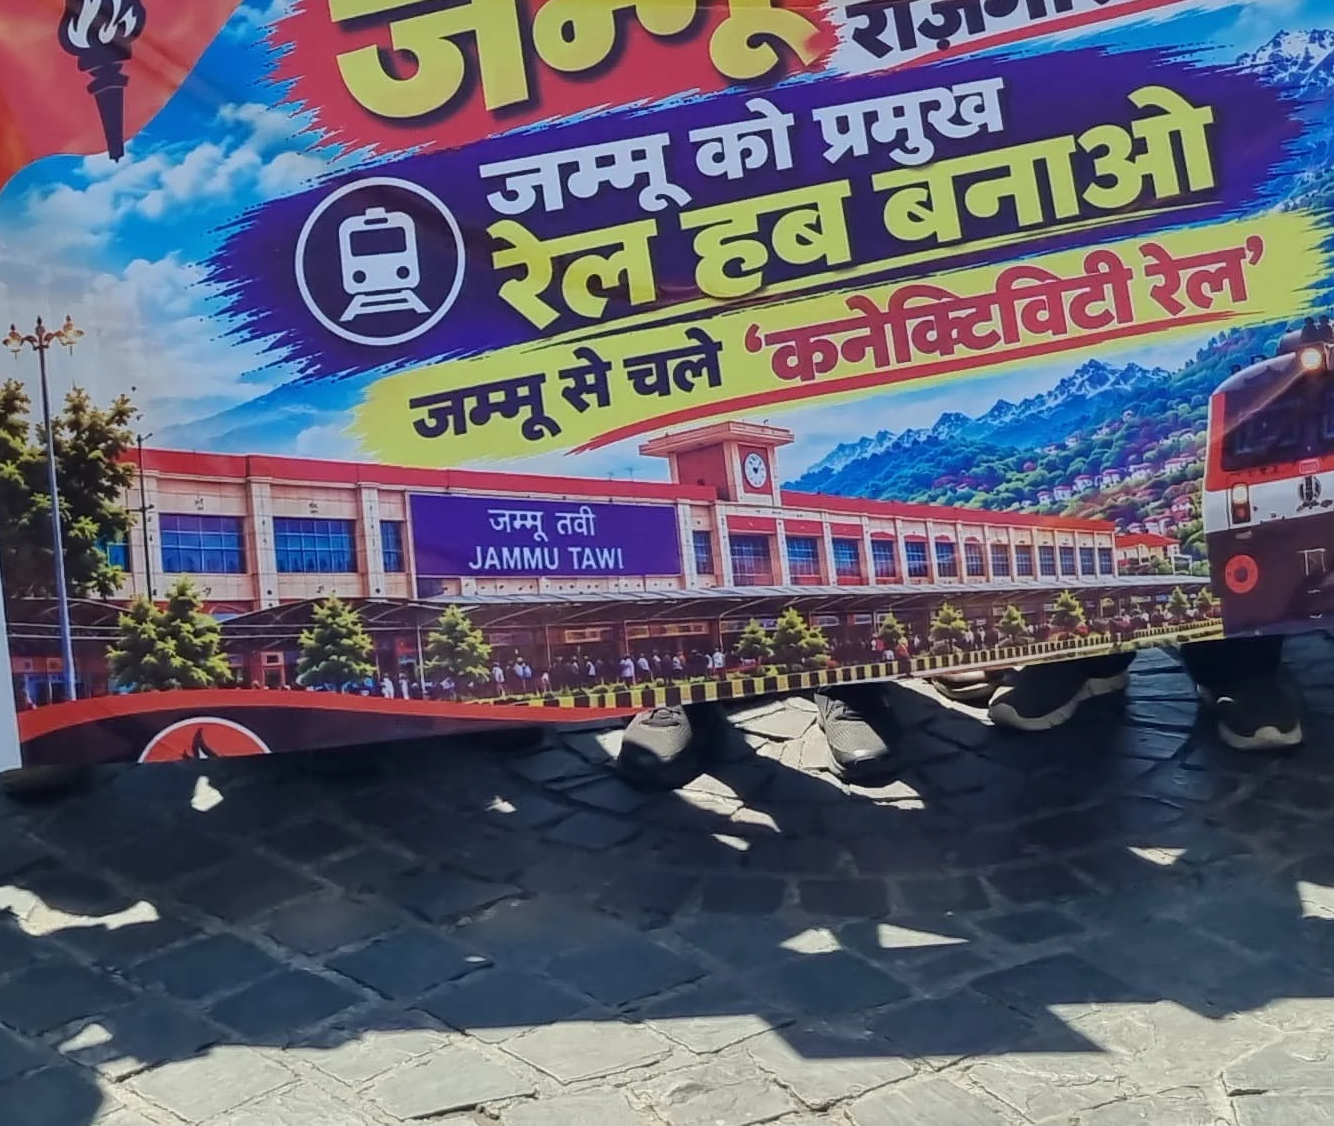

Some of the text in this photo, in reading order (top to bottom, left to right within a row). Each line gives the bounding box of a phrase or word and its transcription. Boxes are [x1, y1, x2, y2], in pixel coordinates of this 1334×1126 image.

[480, 78, 1005, 216] जम्मू को प्रमुख
[492, 84, 1218, 330] रेल हब बनाओ
[410, 371, 556, 444] जम्मू
[560, 347, 612, 411] से
[625, 328, 726, 401] चले
[469, 543, 625, 571] JAMMU TAWI
[489, 503, 597, 540] जम्मू तवी
